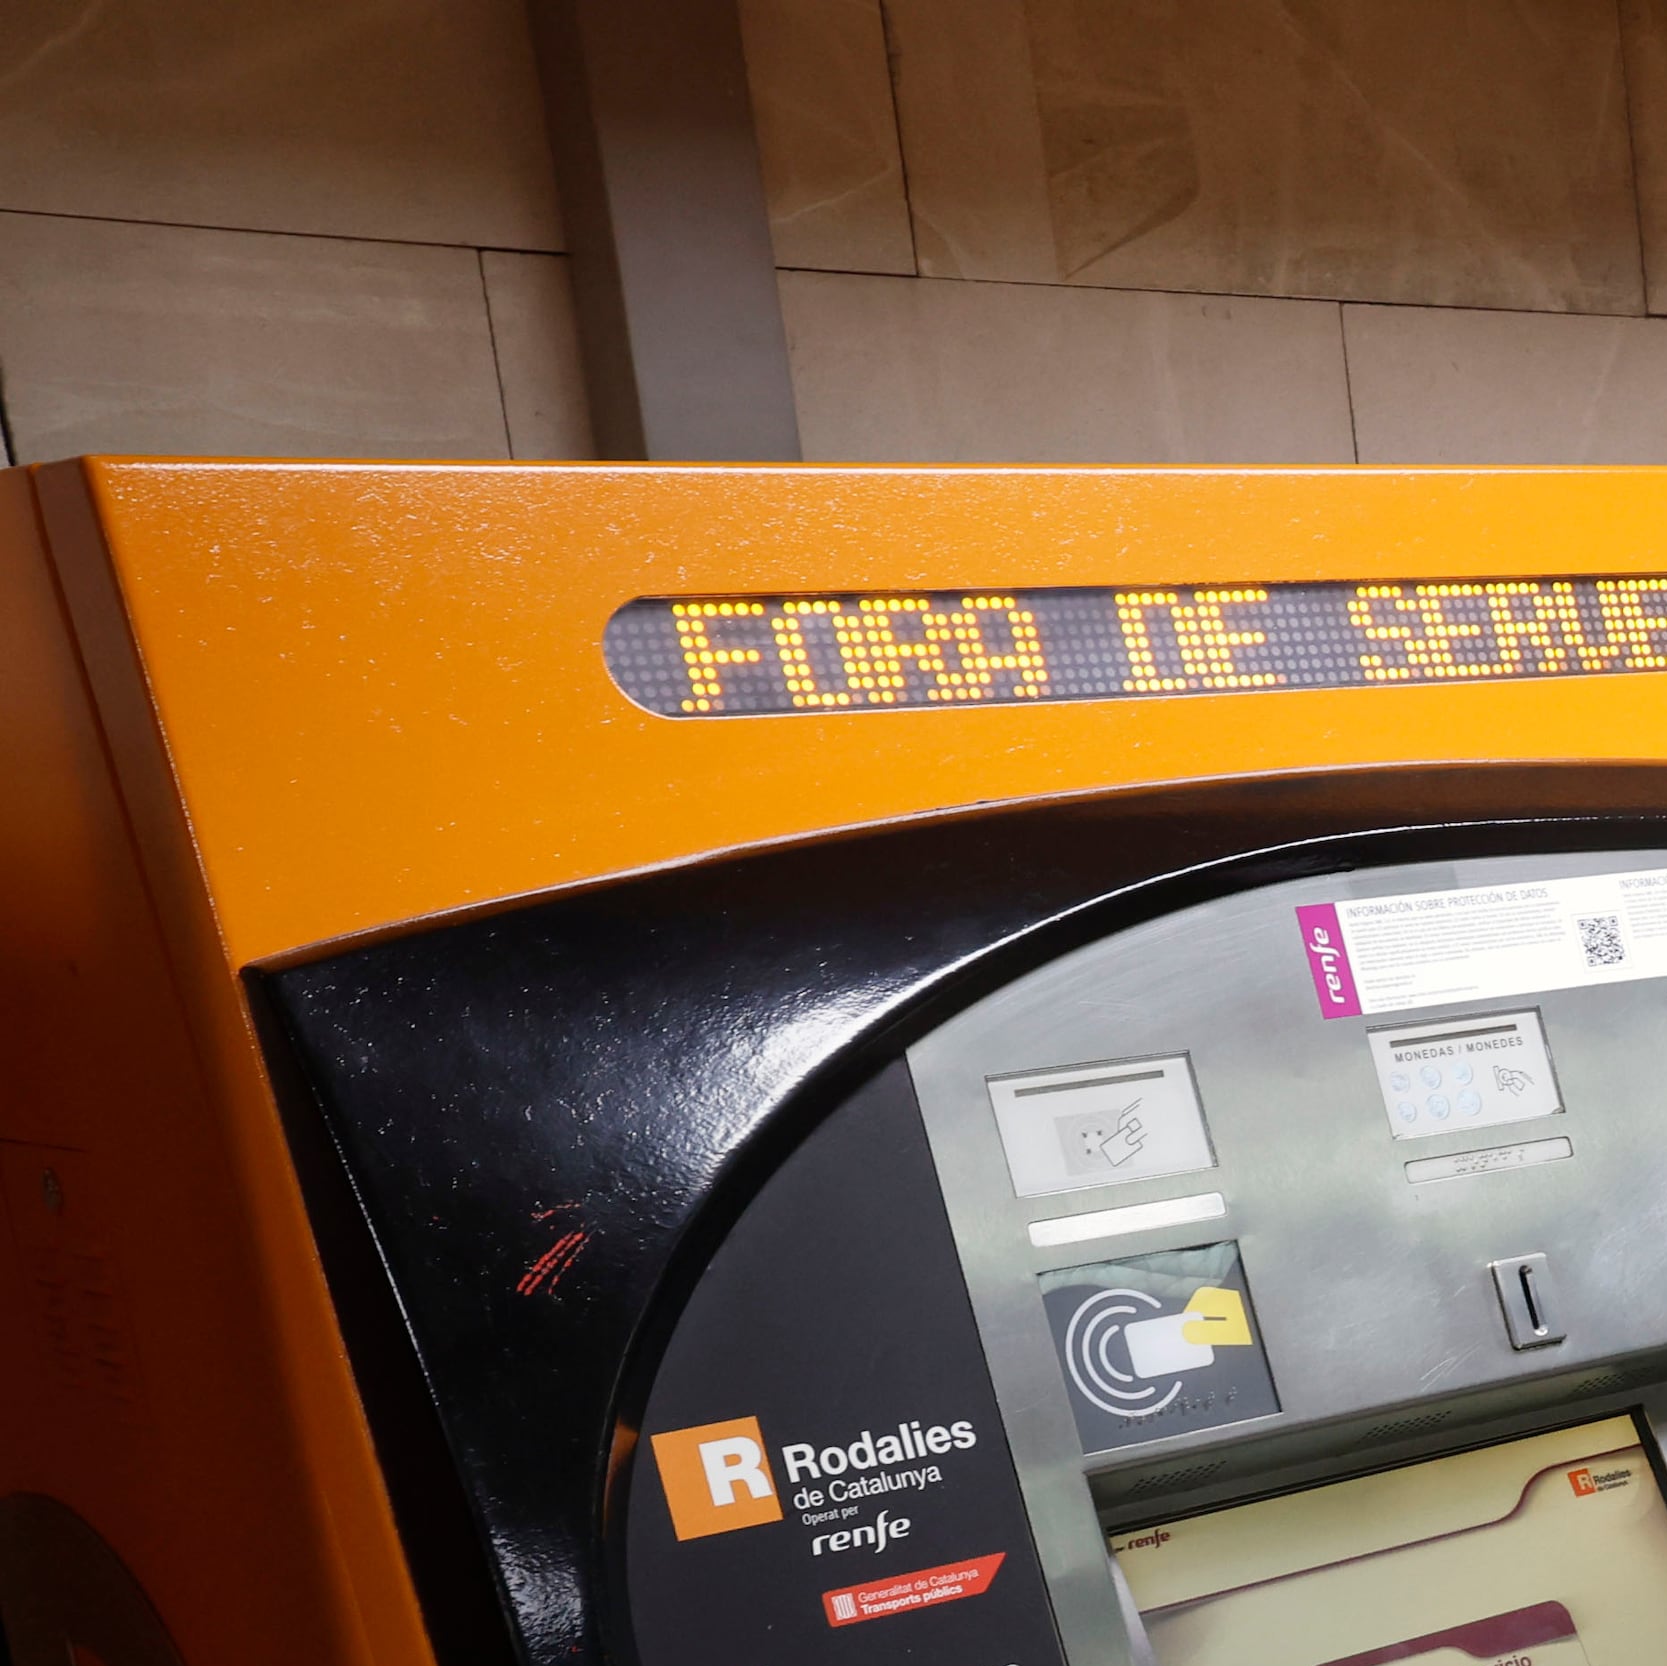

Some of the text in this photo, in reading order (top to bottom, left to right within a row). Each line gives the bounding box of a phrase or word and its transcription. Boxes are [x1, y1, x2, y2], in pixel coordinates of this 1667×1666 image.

[672, 597, 1048, 713] FORA
[1115, 589, 1278, 691] DE
[1346, 887, 1549, 918] INFORMACIÓN SOBRE PROTECCIÓN DE DATOS
[1308, 925, 1346, 1004] renfe
[1394, 1045, 1455, 1063] MONEDAS
[1466, 1036, 1525, 1053] MONEDES
[698, 1435, 774, 1508] R
[782, 1419, 978, 1484] Rodalies
[792, 1462, 943, 1510] de Catalunya
[801, 1505, 859, 1527] Operat per
[811, 1509, 912, 1556] renfe
[858, 1568, 980, 1603] Generalitat de Catalunya
[860, 1584, 963, 1615] Transports públics
